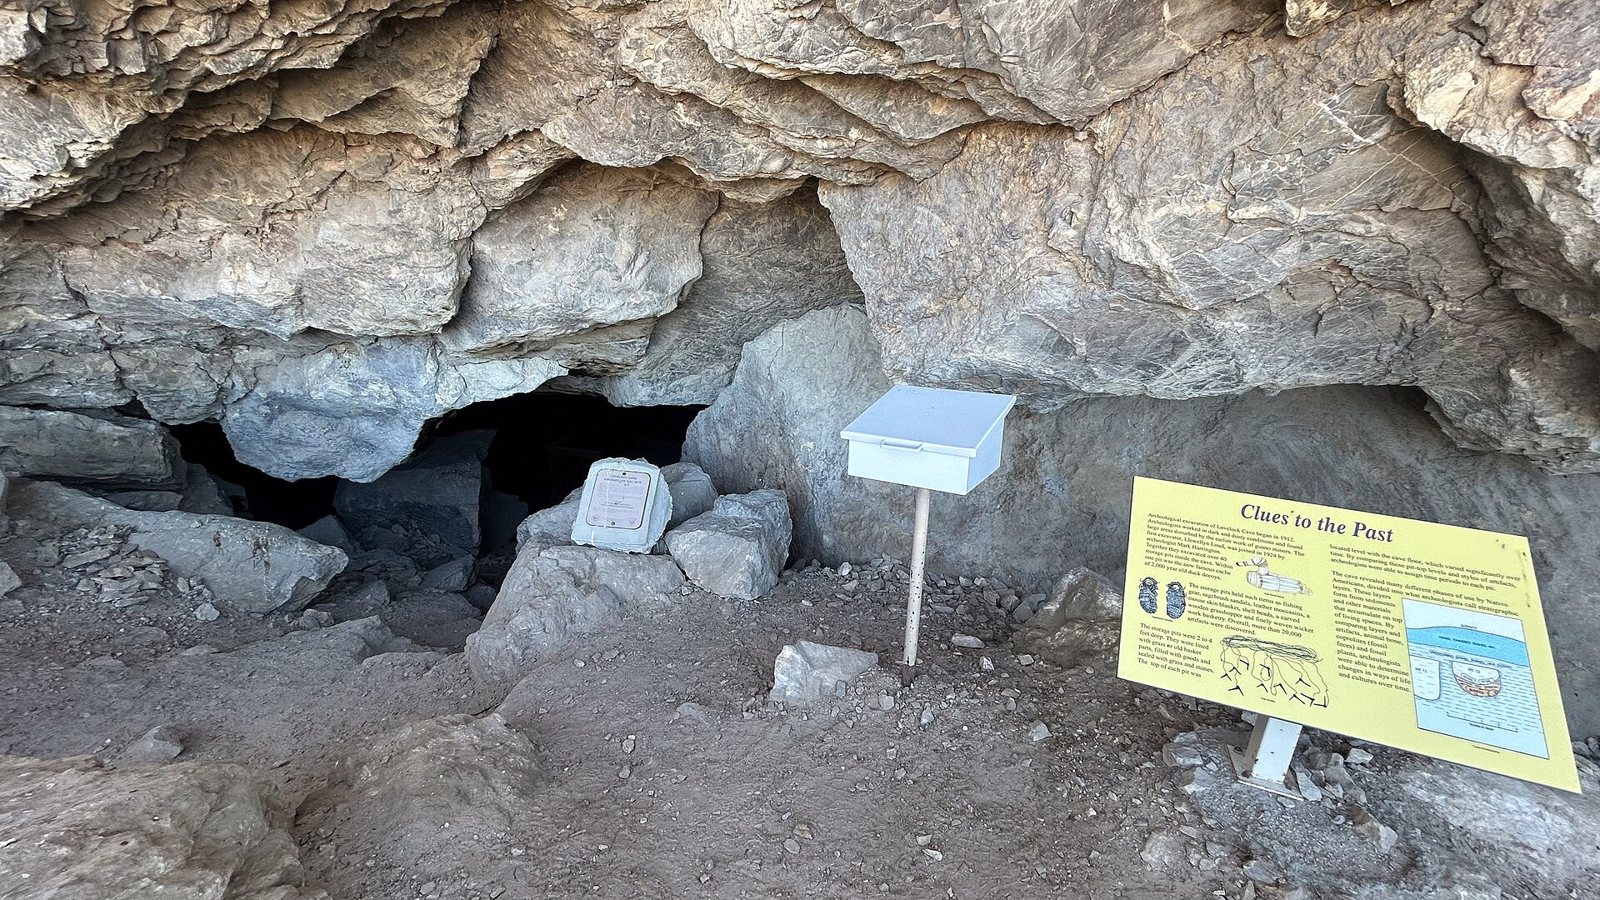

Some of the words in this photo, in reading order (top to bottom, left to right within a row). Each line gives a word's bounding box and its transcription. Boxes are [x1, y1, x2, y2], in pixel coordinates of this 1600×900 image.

[1148, 513, 1182, 523] Archeological
[1217, 524, 1240, 533] Lovelock
[1256, 531, 1272, 539] began
[1241, 504, 1289, 526] Clues
[1294, 512, 1312, 530] to
[1317, 516, 1346, 536] the
[1351, 521, 1394, 543] Past
[1146, 536, 1176, 547] archeologist
[1147, 518, 1181, 529] Archeologists
[1182, 524, 1201, 532] worked
[1287, 542, 1303, 550] found
[1146, 542, 1167, 551] Together
[1168, 546, 1179, 554] they
[1181, 549, 1206, 557] excavated
[1238, 547, 1255, 555] joined
[1330, 544, 1350, 552] located
[1407, 557, 1424, 565] floor,
[1424, 560, 1444, 568] which
[1445, 564, 1465, 572] varied
[1145, 548, 1163, 557] storage
[1215, 561, 1233, 569] Within
[1196, 564, 1215, 572] famous
[1331, 557, 1367, 569] archeologists
[1438, 576, 1462, 586] periods
[1356, 555, 1388, 566] comparing
[1428, 568, 1447, 576] levels
[1460, 573, 1480, 583] styles
[1200, 584, 1219, 594] storage
[1283, 601, 1303, 611] fishing
[1332, 584, 1351, 593] layers.
[1353, 588, 1371, 596] These
[1373, 591, 1392, 601] layers
[1332, 577, 1366, 588] Americans,
[1367, 583, 1390, 592] divided
[1405, 590, 1420, 598] what
[1421, 594, 1464, 607] archeologists
[1464, 601, 1477, 609] call
[1359, 575, 1385, 585] revealed
[1386, 581, 1403, 589] many
[1404, 583, 1431, 593] different
[1432, 589, 1454, 599] phases
[1486, 598, 1509, 607] Native
[1202, 592, 1229, 603] sagebrush
[1230, 597, 1252, 607] sandals,
[1253, 602, 1272, 611] leather
[1345, 600, 1361, 608] other
[1363, 603, 1391, 613] materials
[1365, 597, 1396, 608] sediments
[1188, 602, 1209, 611] wooden
[1210, 607, 1242, 619] grasshopper
[1256, 616, 1272, 625] finely
[1273, 621, 1293, 629] woven
[1294, 624, 1314, 633] wicker
[1219, 602, 1241, 611] blanket,
[1257, 610, 1274, 618] beads,
[1280, 614, 1300, 623] carved
[1347, 607, 1381, 619] accumulate
[1392, 616, 1403, 624] top
[1187, 615, 1209, 625] artifacts
[1225, 624, 1256, 635] discovered.
[1228, 617, 1250, 627] Overall,
[1334, 619, 1368, 632] comparing
[1369, 626, 1388, 636] layers
[1342, 613, 1360, 623] living
[1362, 618, 1384, 628] spaces.
[1385, 622, 1395, 630] By
[1151, 625, 1170, 635] storage
[1171, 629, 1181, 638] pits
[1363, 632, 1385, 641] animal
[1386, 637, 1404, 646] bone,
[1150, 632, 1164, 641] deep.
[1166, 635, 1179, 644] They
[1195, 642, 1209, 650] lined
[1152, 640, 1166, 648] grass
[1184, 646, 1201, 655] basket
[1367, 640, 1388, 651] (fossil
[1154, 647, 1169, 655] filled
[1183, 653, 1199, 663] goods
[1337, 648, 1358, 659] plants,
[1359, 653, 1401, 669] archeologists
[1370, 648, 1387, 657] fossil
[1137, 657, 1148, 665] The
[1150, 661, 1160, 669] top
[1167, 665, 1181, 673] each
[1169, 659, 1183, 667] grass
[1354, 660, 1368, 668] able
[1338, 663, 1364, 676] changes
[1373, 672, 1390, 681] ways
[1400, 677, 1411, 685] life
[1351, 674, 1377, 685] cultures
